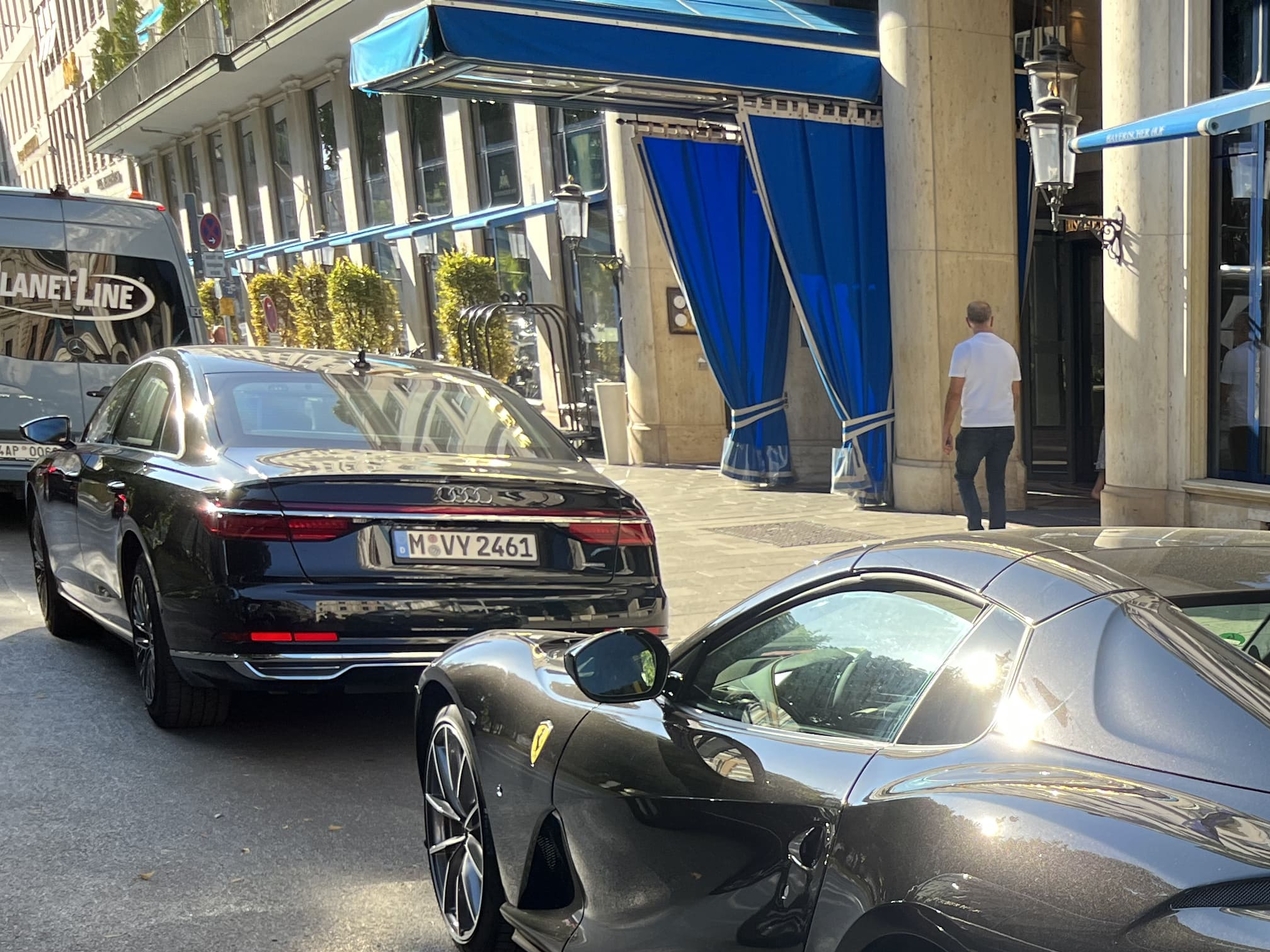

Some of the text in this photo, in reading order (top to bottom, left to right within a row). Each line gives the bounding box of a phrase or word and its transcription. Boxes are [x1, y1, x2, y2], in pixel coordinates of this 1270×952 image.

[408, 533, 533, 558] M VY 2461
